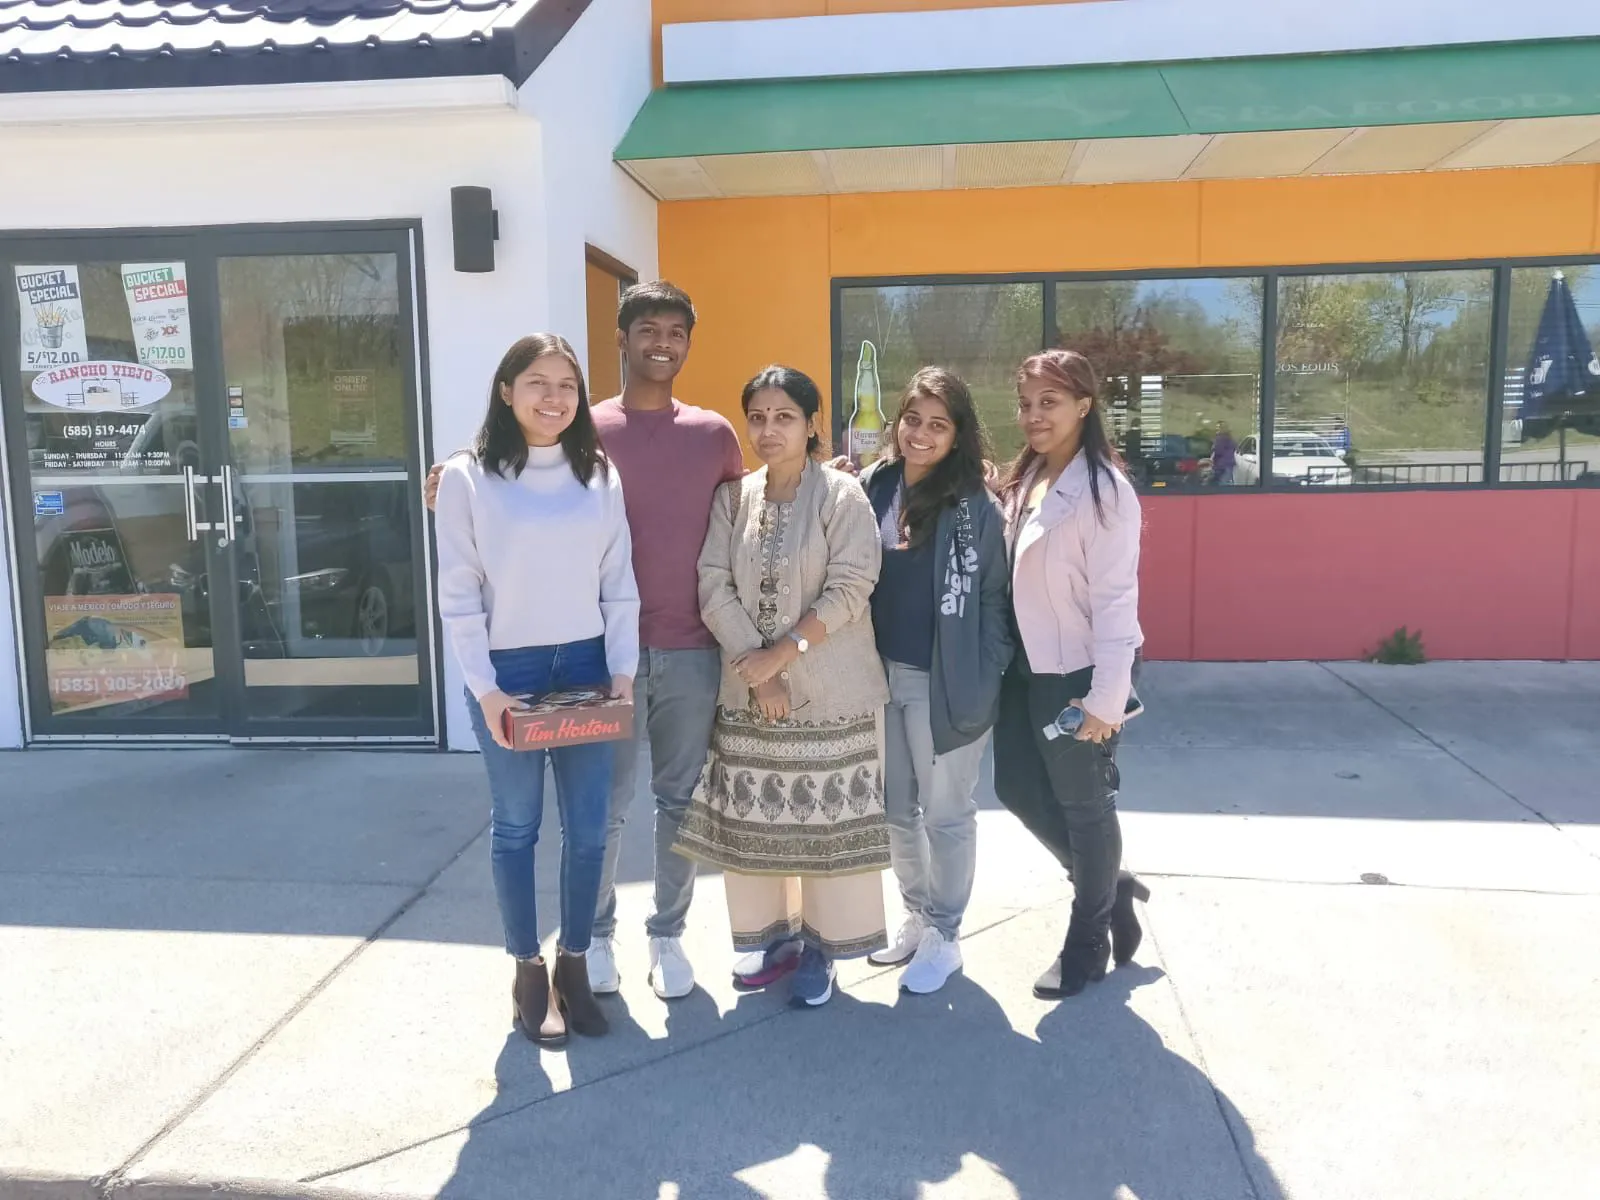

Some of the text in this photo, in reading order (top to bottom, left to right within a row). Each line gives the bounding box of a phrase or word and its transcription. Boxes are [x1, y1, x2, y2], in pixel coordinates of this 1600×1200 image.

[20, 271, 64, 289] BUCKET
[126, 268, 171, 287] BUCKET
[30, 284, 75, 303] SPECIAL
[135, 282, 183, 301] SPECIAL
[48, 364, 153, 384] RANCHO VIEJO
[63, 424, 146, 438] (585) 519-4474
[70, 540, 117, 567] Modelo
[54, 678, 99, 694] (585)
[523, 717, 621, 743] Tim Hortons
